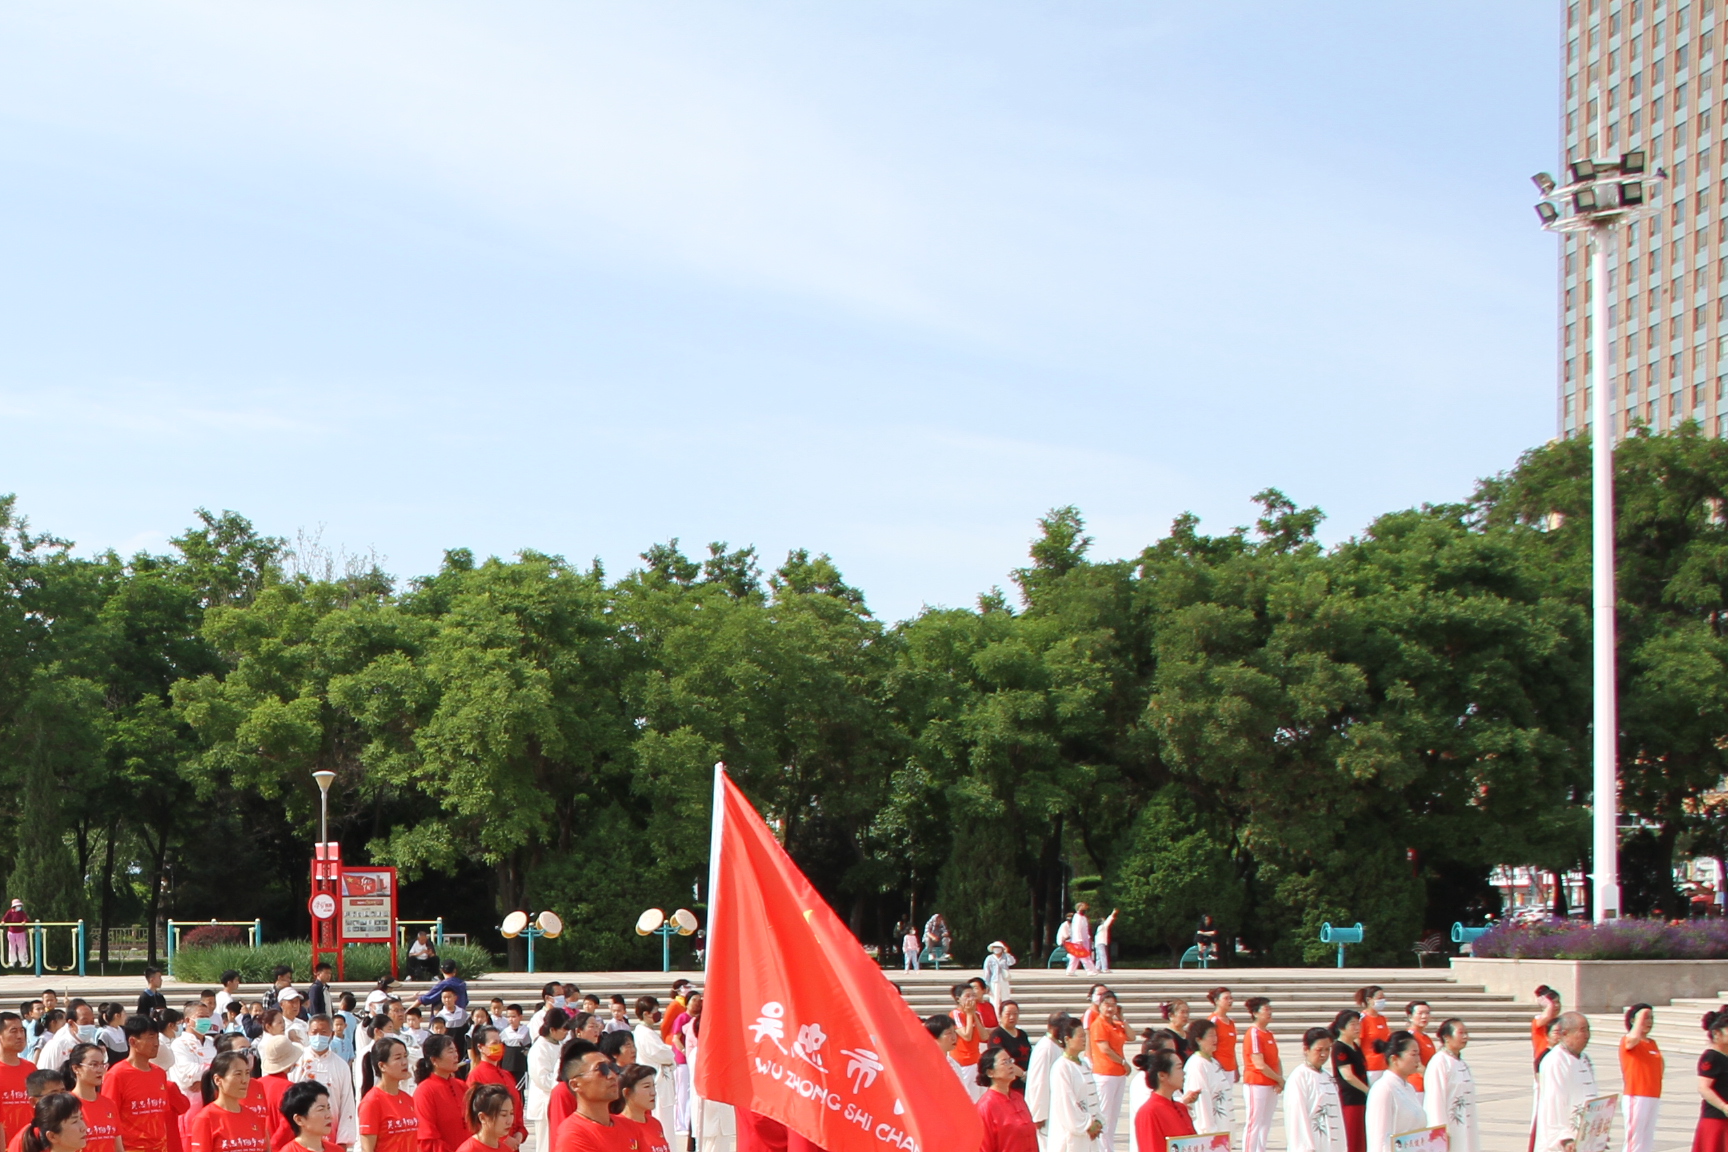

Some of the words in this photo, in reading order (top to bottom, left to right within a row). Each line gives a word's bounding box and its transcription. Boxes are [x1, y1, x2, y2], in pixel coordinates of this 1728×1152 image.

[749, 1002, 905, 1115] 吴忠市
[755, 1057, 783, 1080] WU
[784, 1070, 842, 1111] ZHONG
[844, 1104, 873, 1131] SHI
